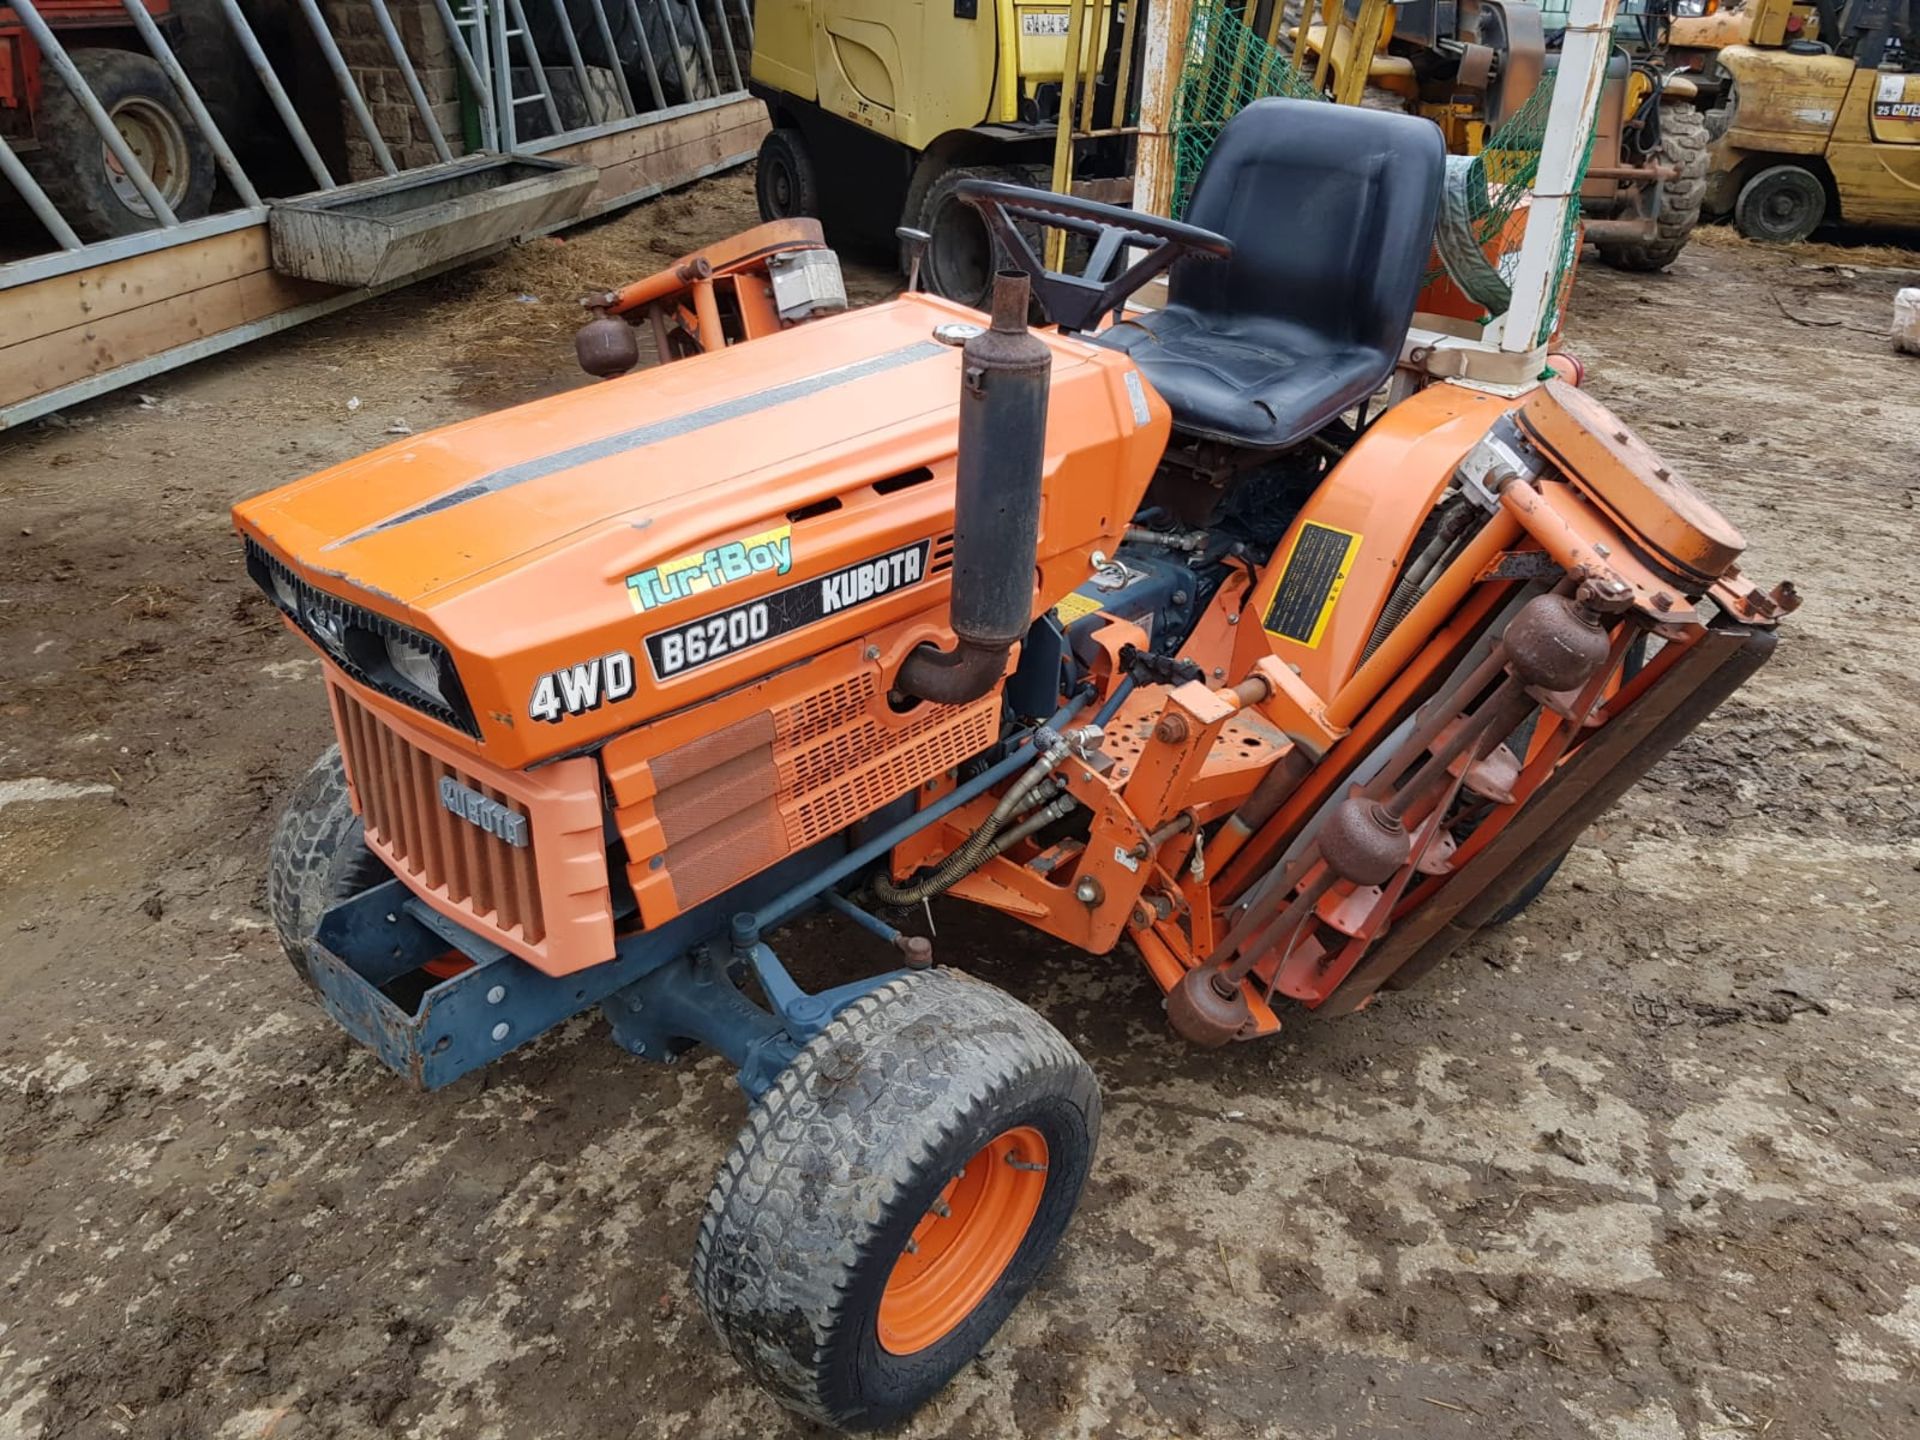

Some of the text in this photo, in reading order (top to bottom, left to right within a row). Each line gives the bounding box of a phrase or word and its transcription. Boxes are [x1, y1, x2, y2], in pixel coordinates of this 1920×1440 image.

[1877, 105, 1890, 116] 25
[625, 534, 792, 611] TurfBoy
[661, 546, 922, 674] B6200 KUBOTA
[529, 649, 636, 724] 4WD
[440, 775, 528, 848] KUBOTA
